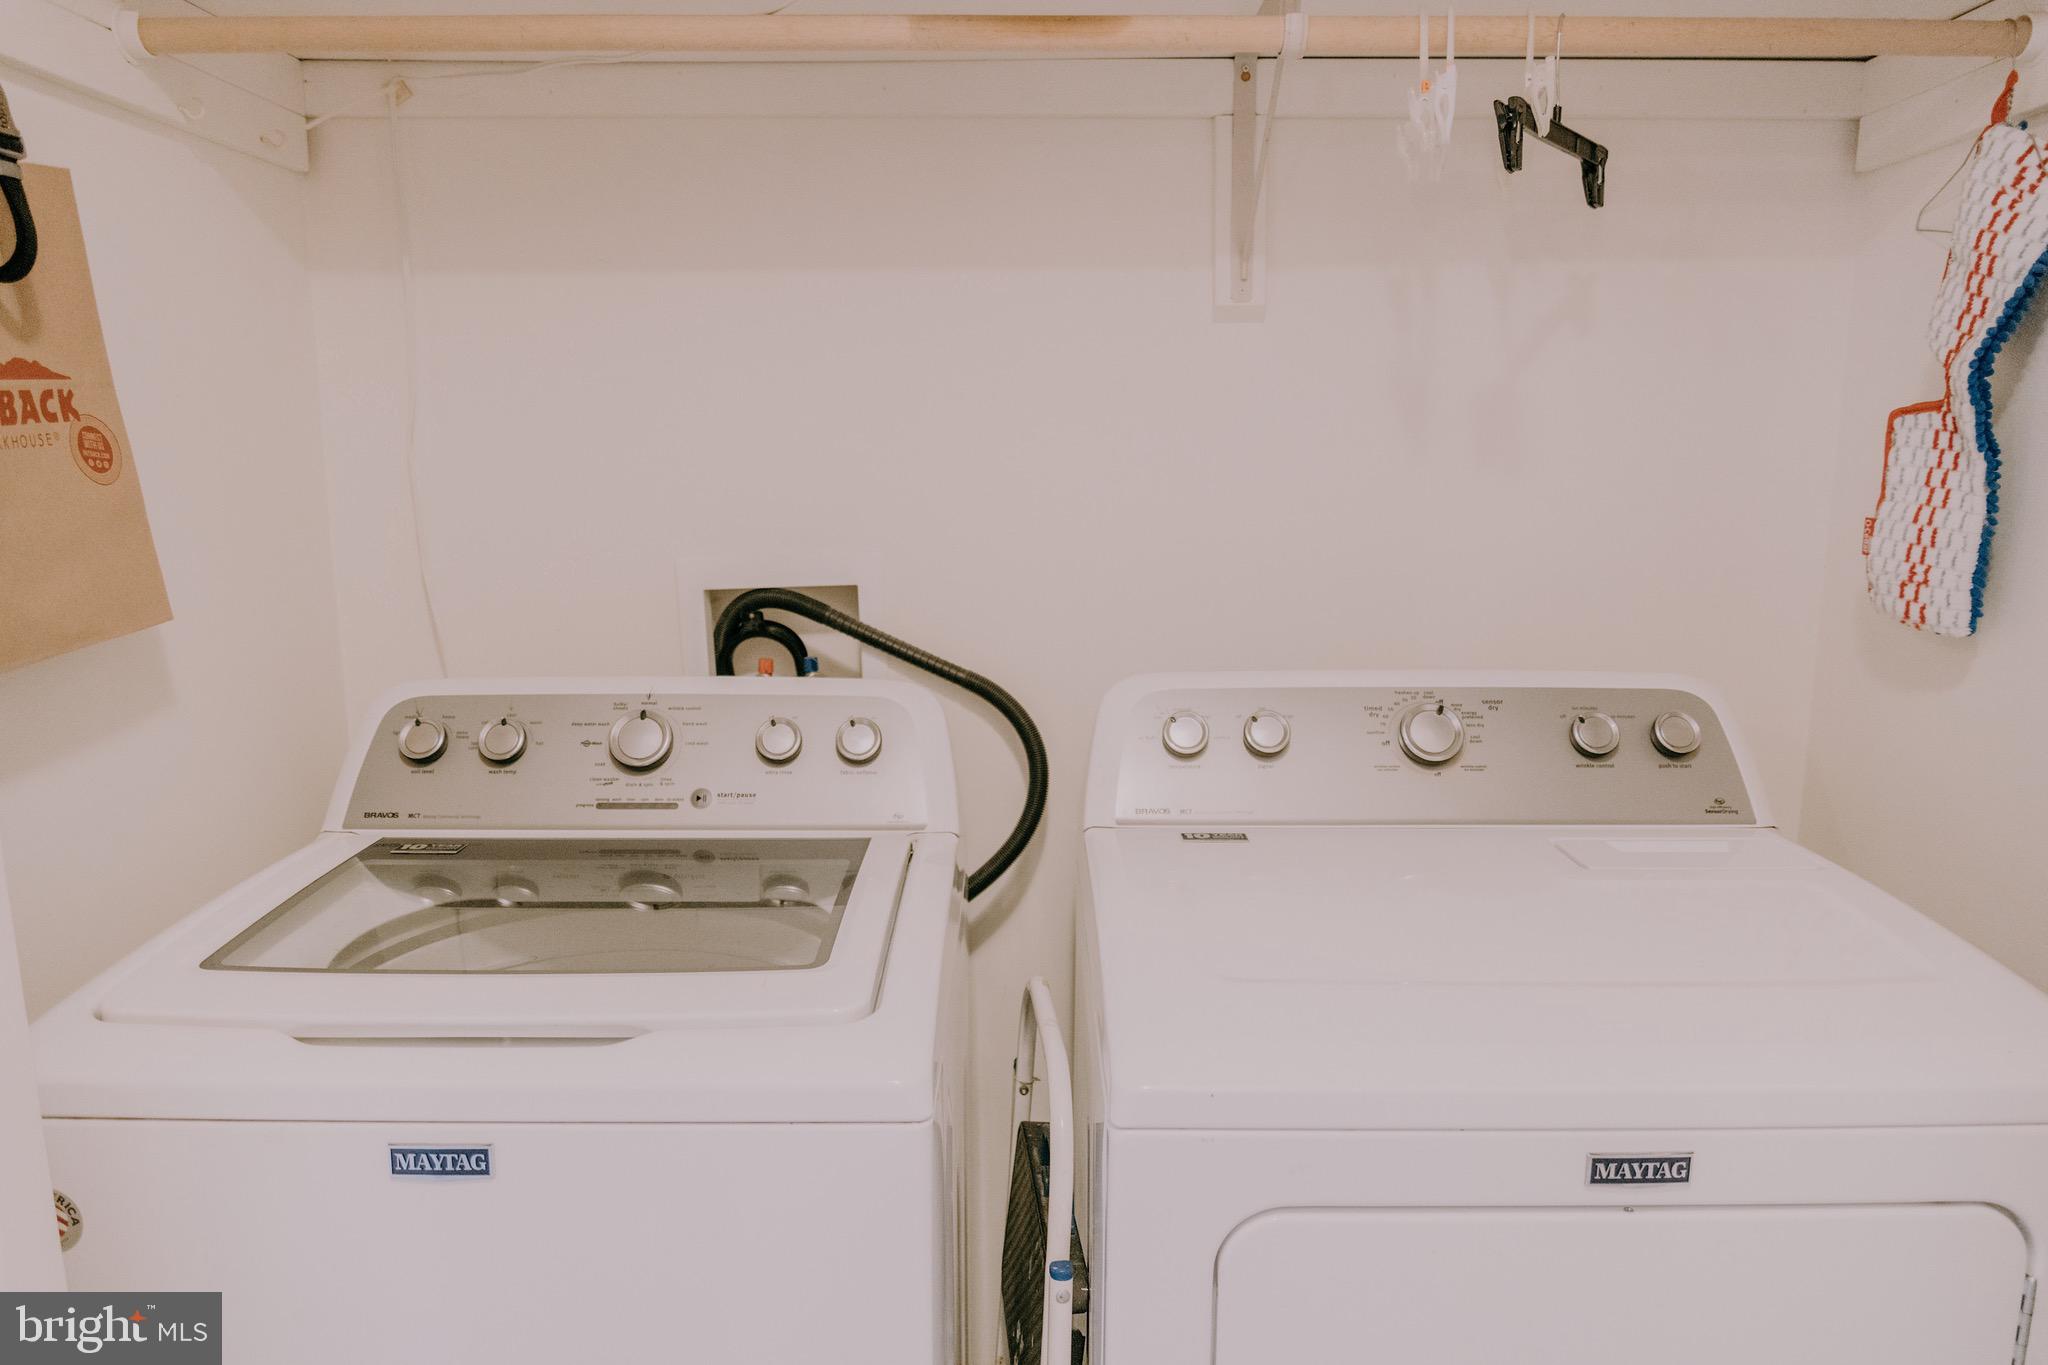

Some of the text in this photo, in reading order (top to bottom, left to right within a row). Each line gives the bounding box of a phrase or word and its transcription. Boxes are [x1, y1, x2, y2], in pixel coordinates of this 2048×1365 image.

[0, 388, 81, 426] BACK
[0, 432, 53, 451] KHOUSE
[393, 1152, 487, 1172] MAYTAG
[1593, 1161, 1687, 1180] MAYTAG
[53, 1192, 81, 1228] RICA
